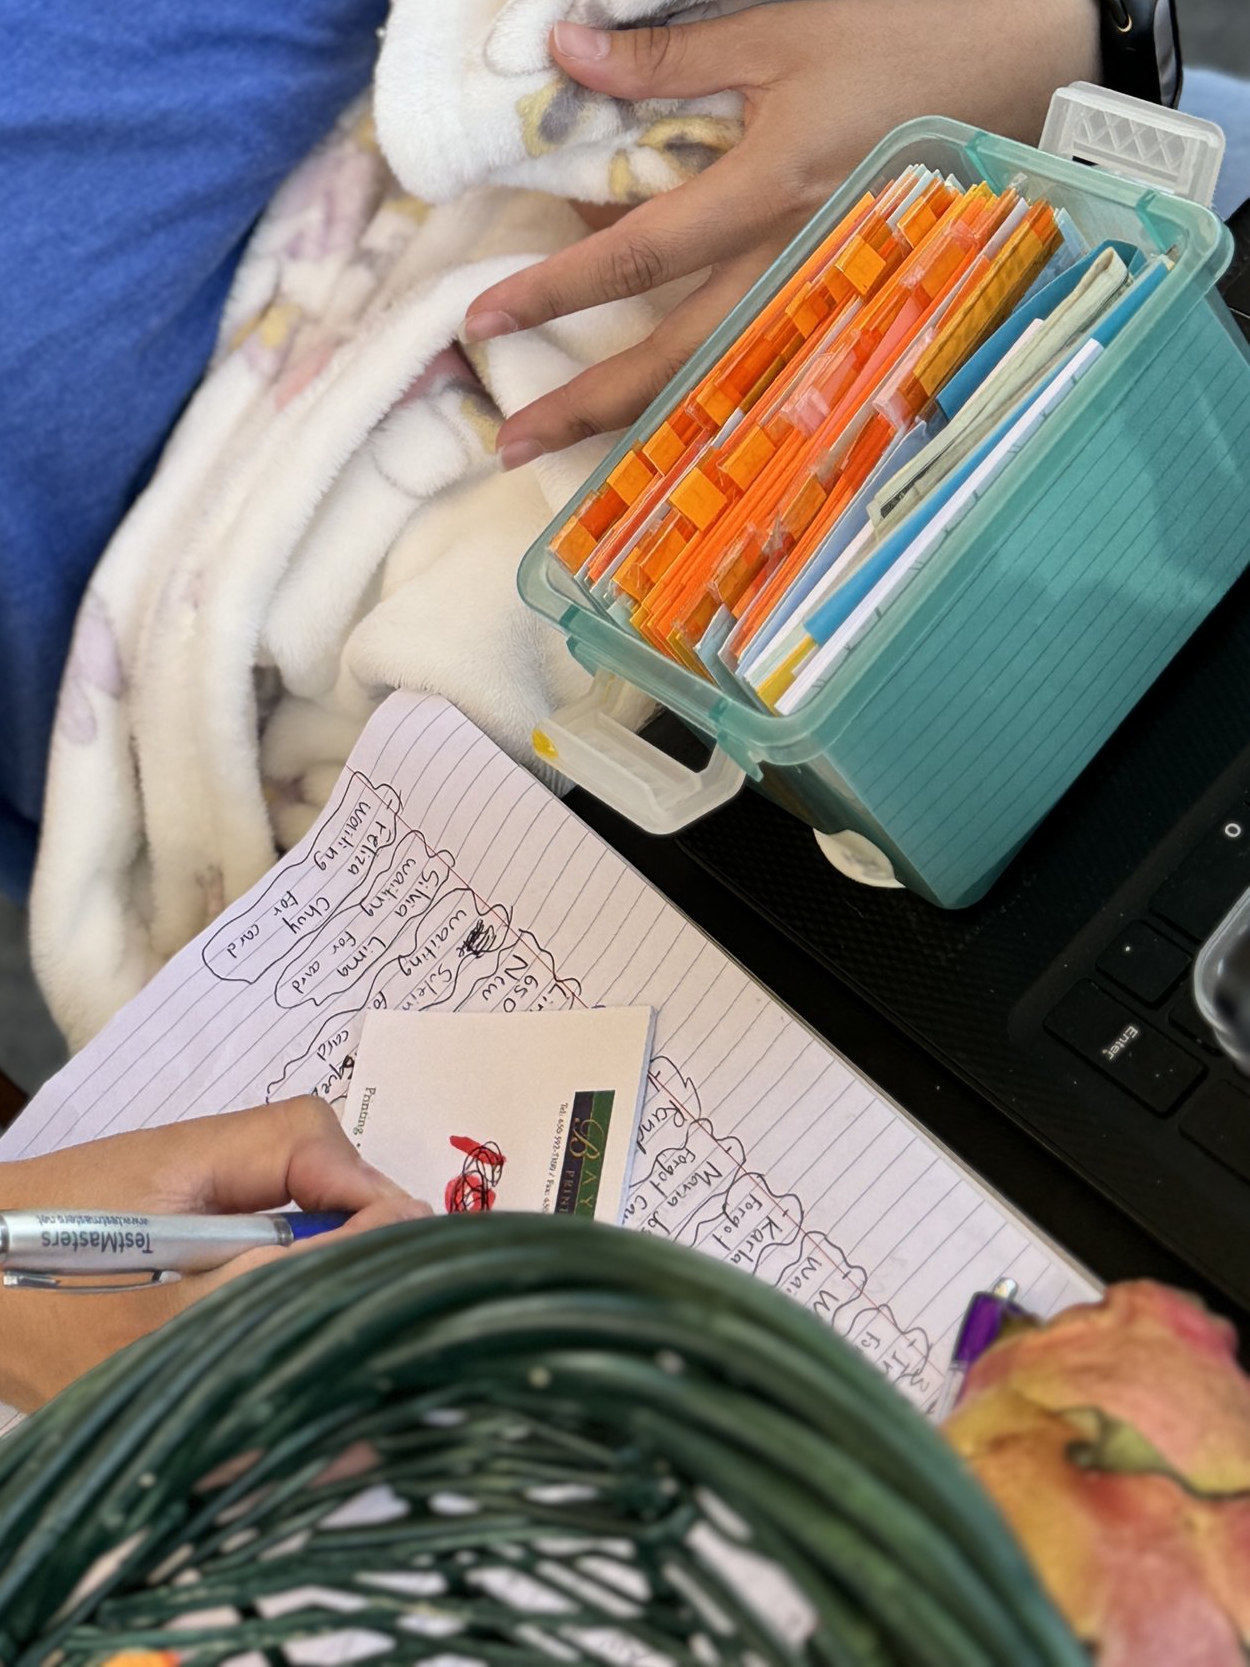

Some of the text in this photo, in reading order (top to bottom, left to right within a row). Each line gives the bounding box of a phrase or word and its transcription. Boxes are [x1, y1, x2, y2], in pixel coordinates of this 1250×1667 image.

[313, 801, 372, 871] waiting
[360, 857, 417, 917] waiting
[282, 896, 331, 934] Chuy
[336, 869, 440, 977] Silvia Lima
[226, 923, 260, 958] card
[316, 908, 467, 1062] waiting fo card
[481, 954, 528, 1002] New
[502, 974, 539, 1013] 650
[1106, 1024, 1139, 1060] Enter
[667, 1160, 724, 1208] Maria
[36, 1214, 149, 1227] www.testmasters.net
[41, 1230, 154, 1254] TestMasters
[711, 1192, 764, 1252] Forgot
[730, 1215, 783, 1264] Karla
